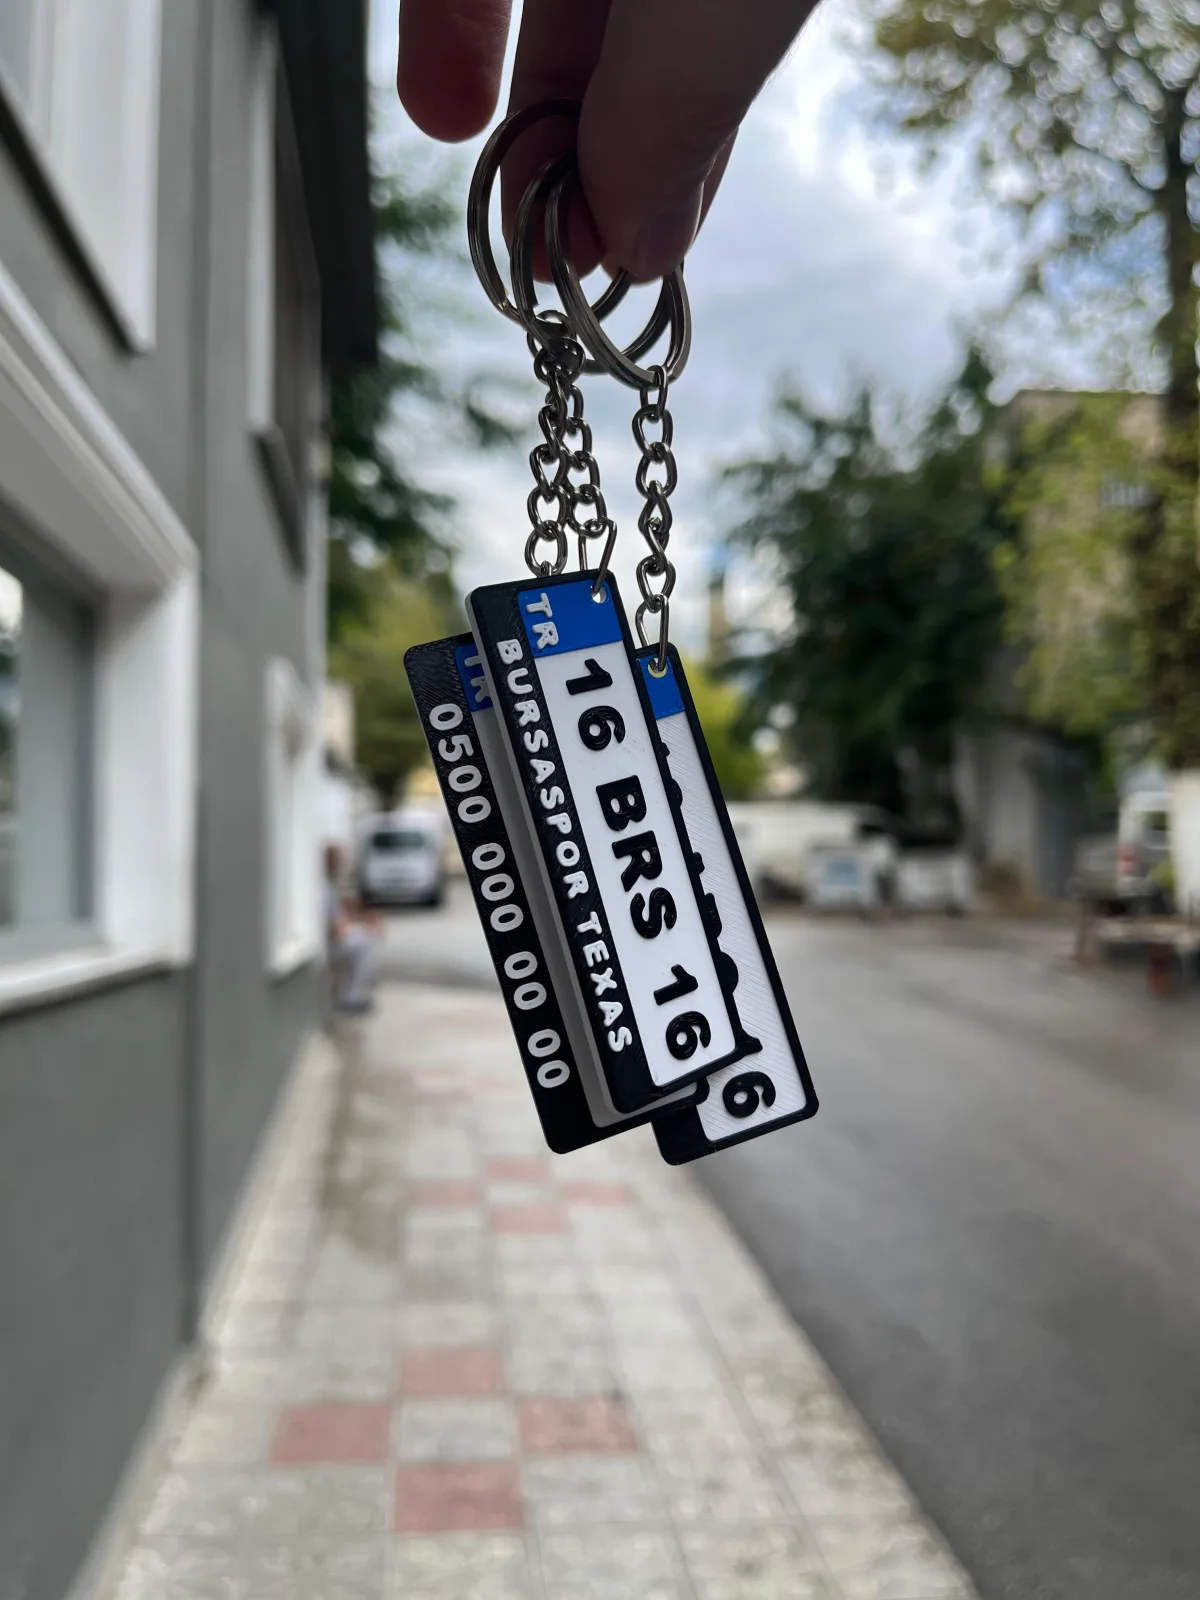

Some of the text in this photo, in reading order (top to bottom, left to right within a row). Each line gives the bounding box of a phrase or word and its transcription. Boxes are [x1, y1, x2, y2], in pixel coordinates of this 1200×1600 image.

[525, 592, 560, 650] TR
[566, 658, 627, 751] 16
[428, 703, 571, 1089] 0500 000 00 00
[496, 638, 634, 1053] BURSASPOR TEXAS
[595, 774, 678, 939] BRS
[653, 963, 712, 1060] 16
